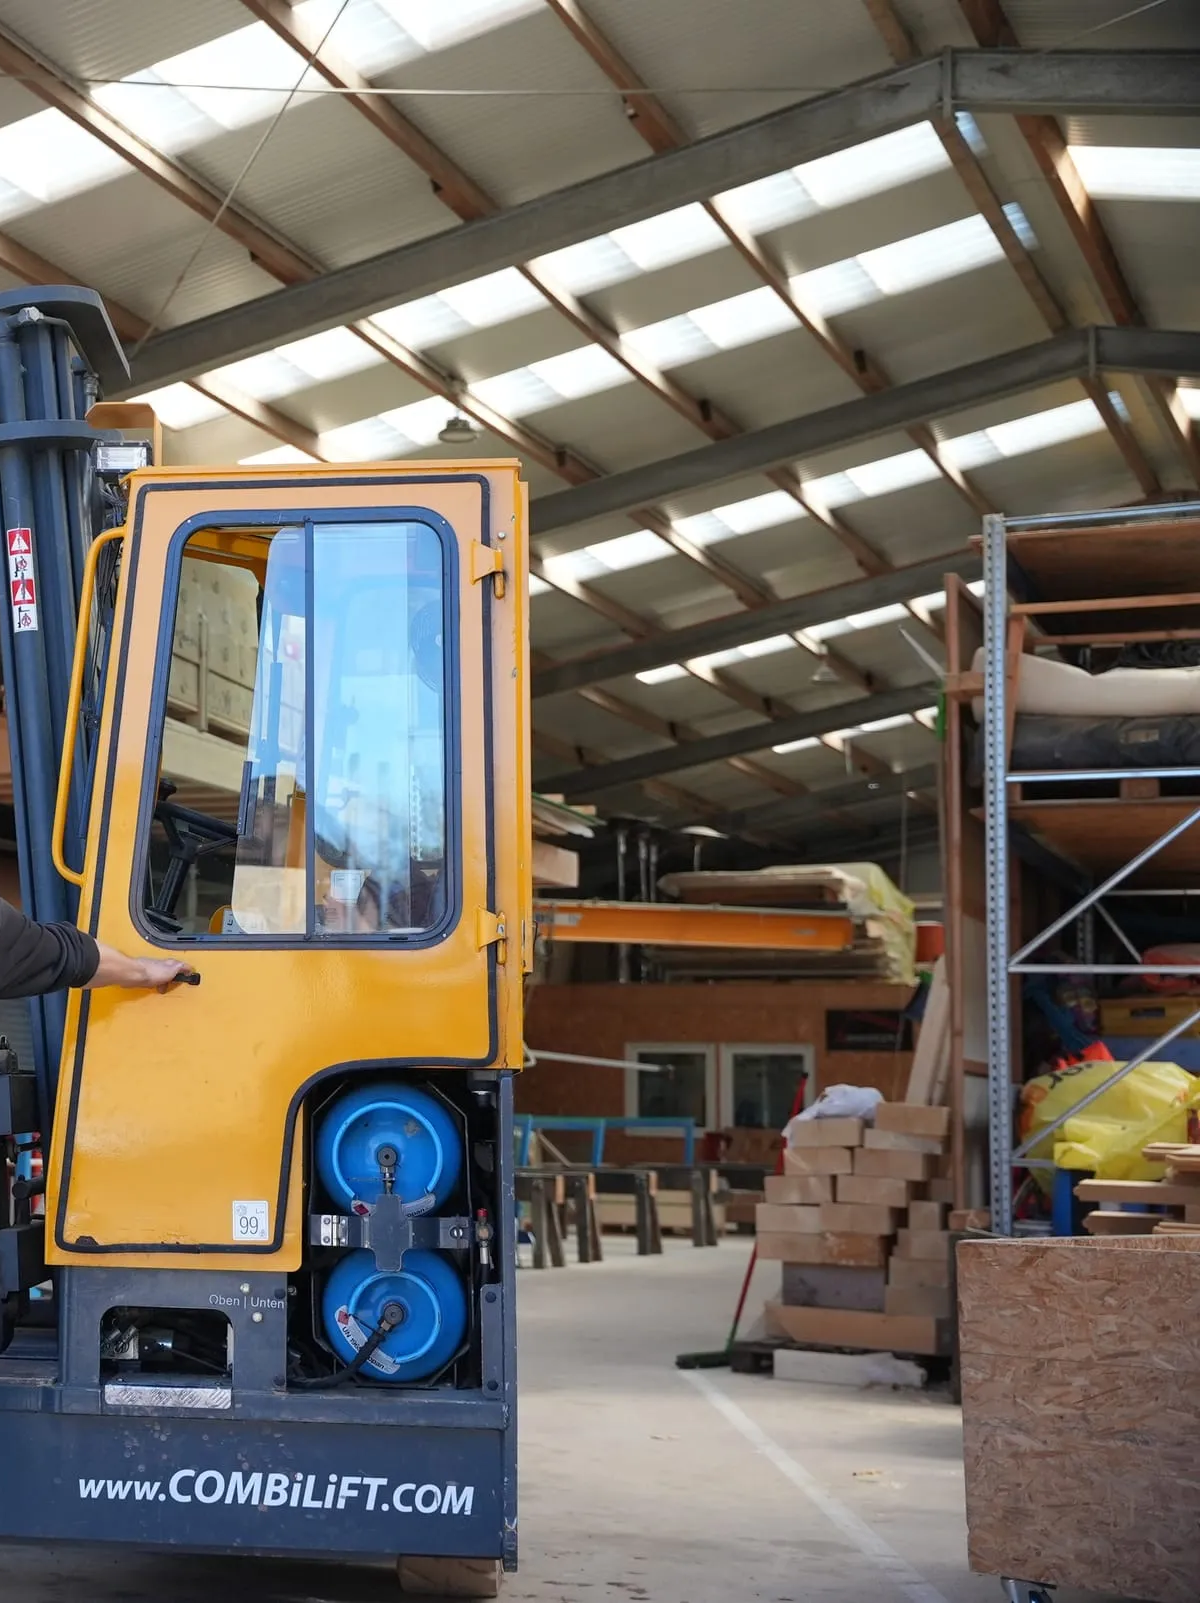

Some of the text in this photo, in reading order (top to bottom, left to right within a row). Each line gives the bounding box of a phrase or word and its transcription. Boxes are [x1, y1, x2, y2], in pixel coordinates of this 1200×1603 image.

[240, 1216, 259, 1235] 99
[209, 1294, 240, 1306] Oben
[250, 1297, 285, 1309] Unten
